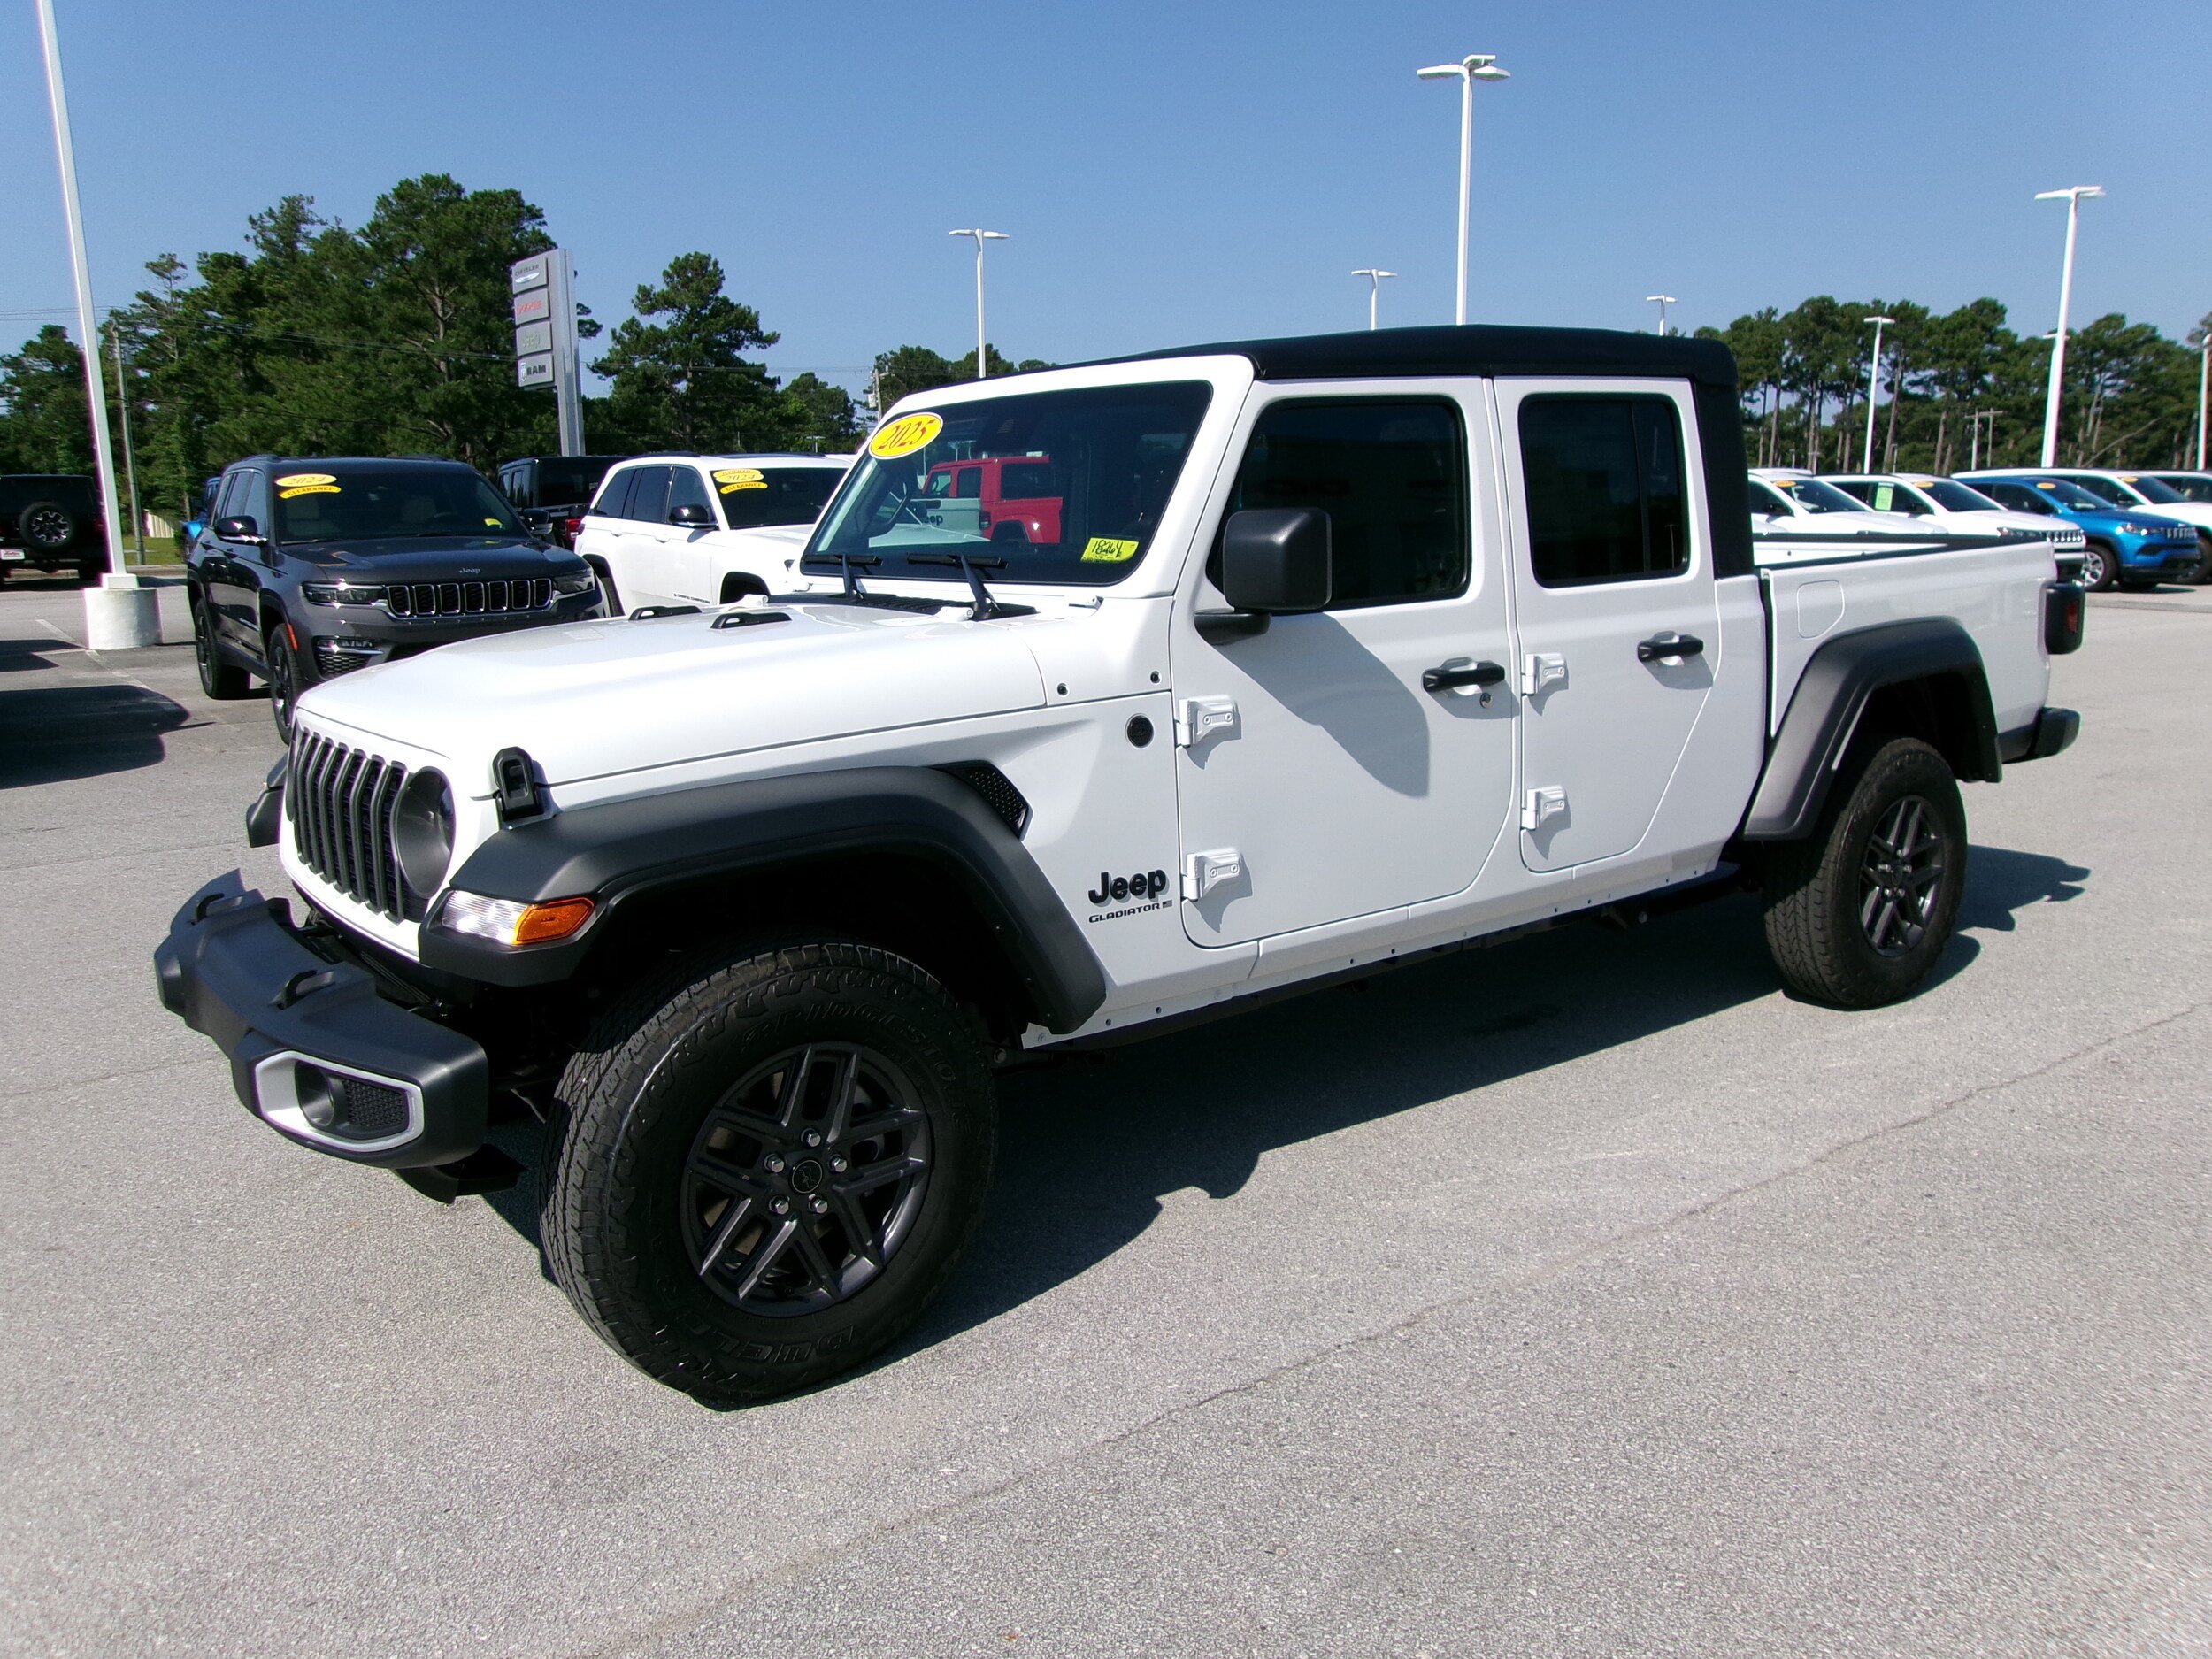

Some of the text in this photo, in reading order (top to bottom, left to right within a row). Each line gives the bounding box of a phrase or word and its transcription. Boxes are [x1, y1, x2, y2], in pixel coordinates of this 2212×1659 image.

[526, 364, 547, 376] RAM
[877, 419, 936, 450] 2025
[287, 486, 334, 496] CLEARANCE
[1088, 869, 1167, 904] Jeep
[1088, 902, 1161, 923] GLADIATOR
